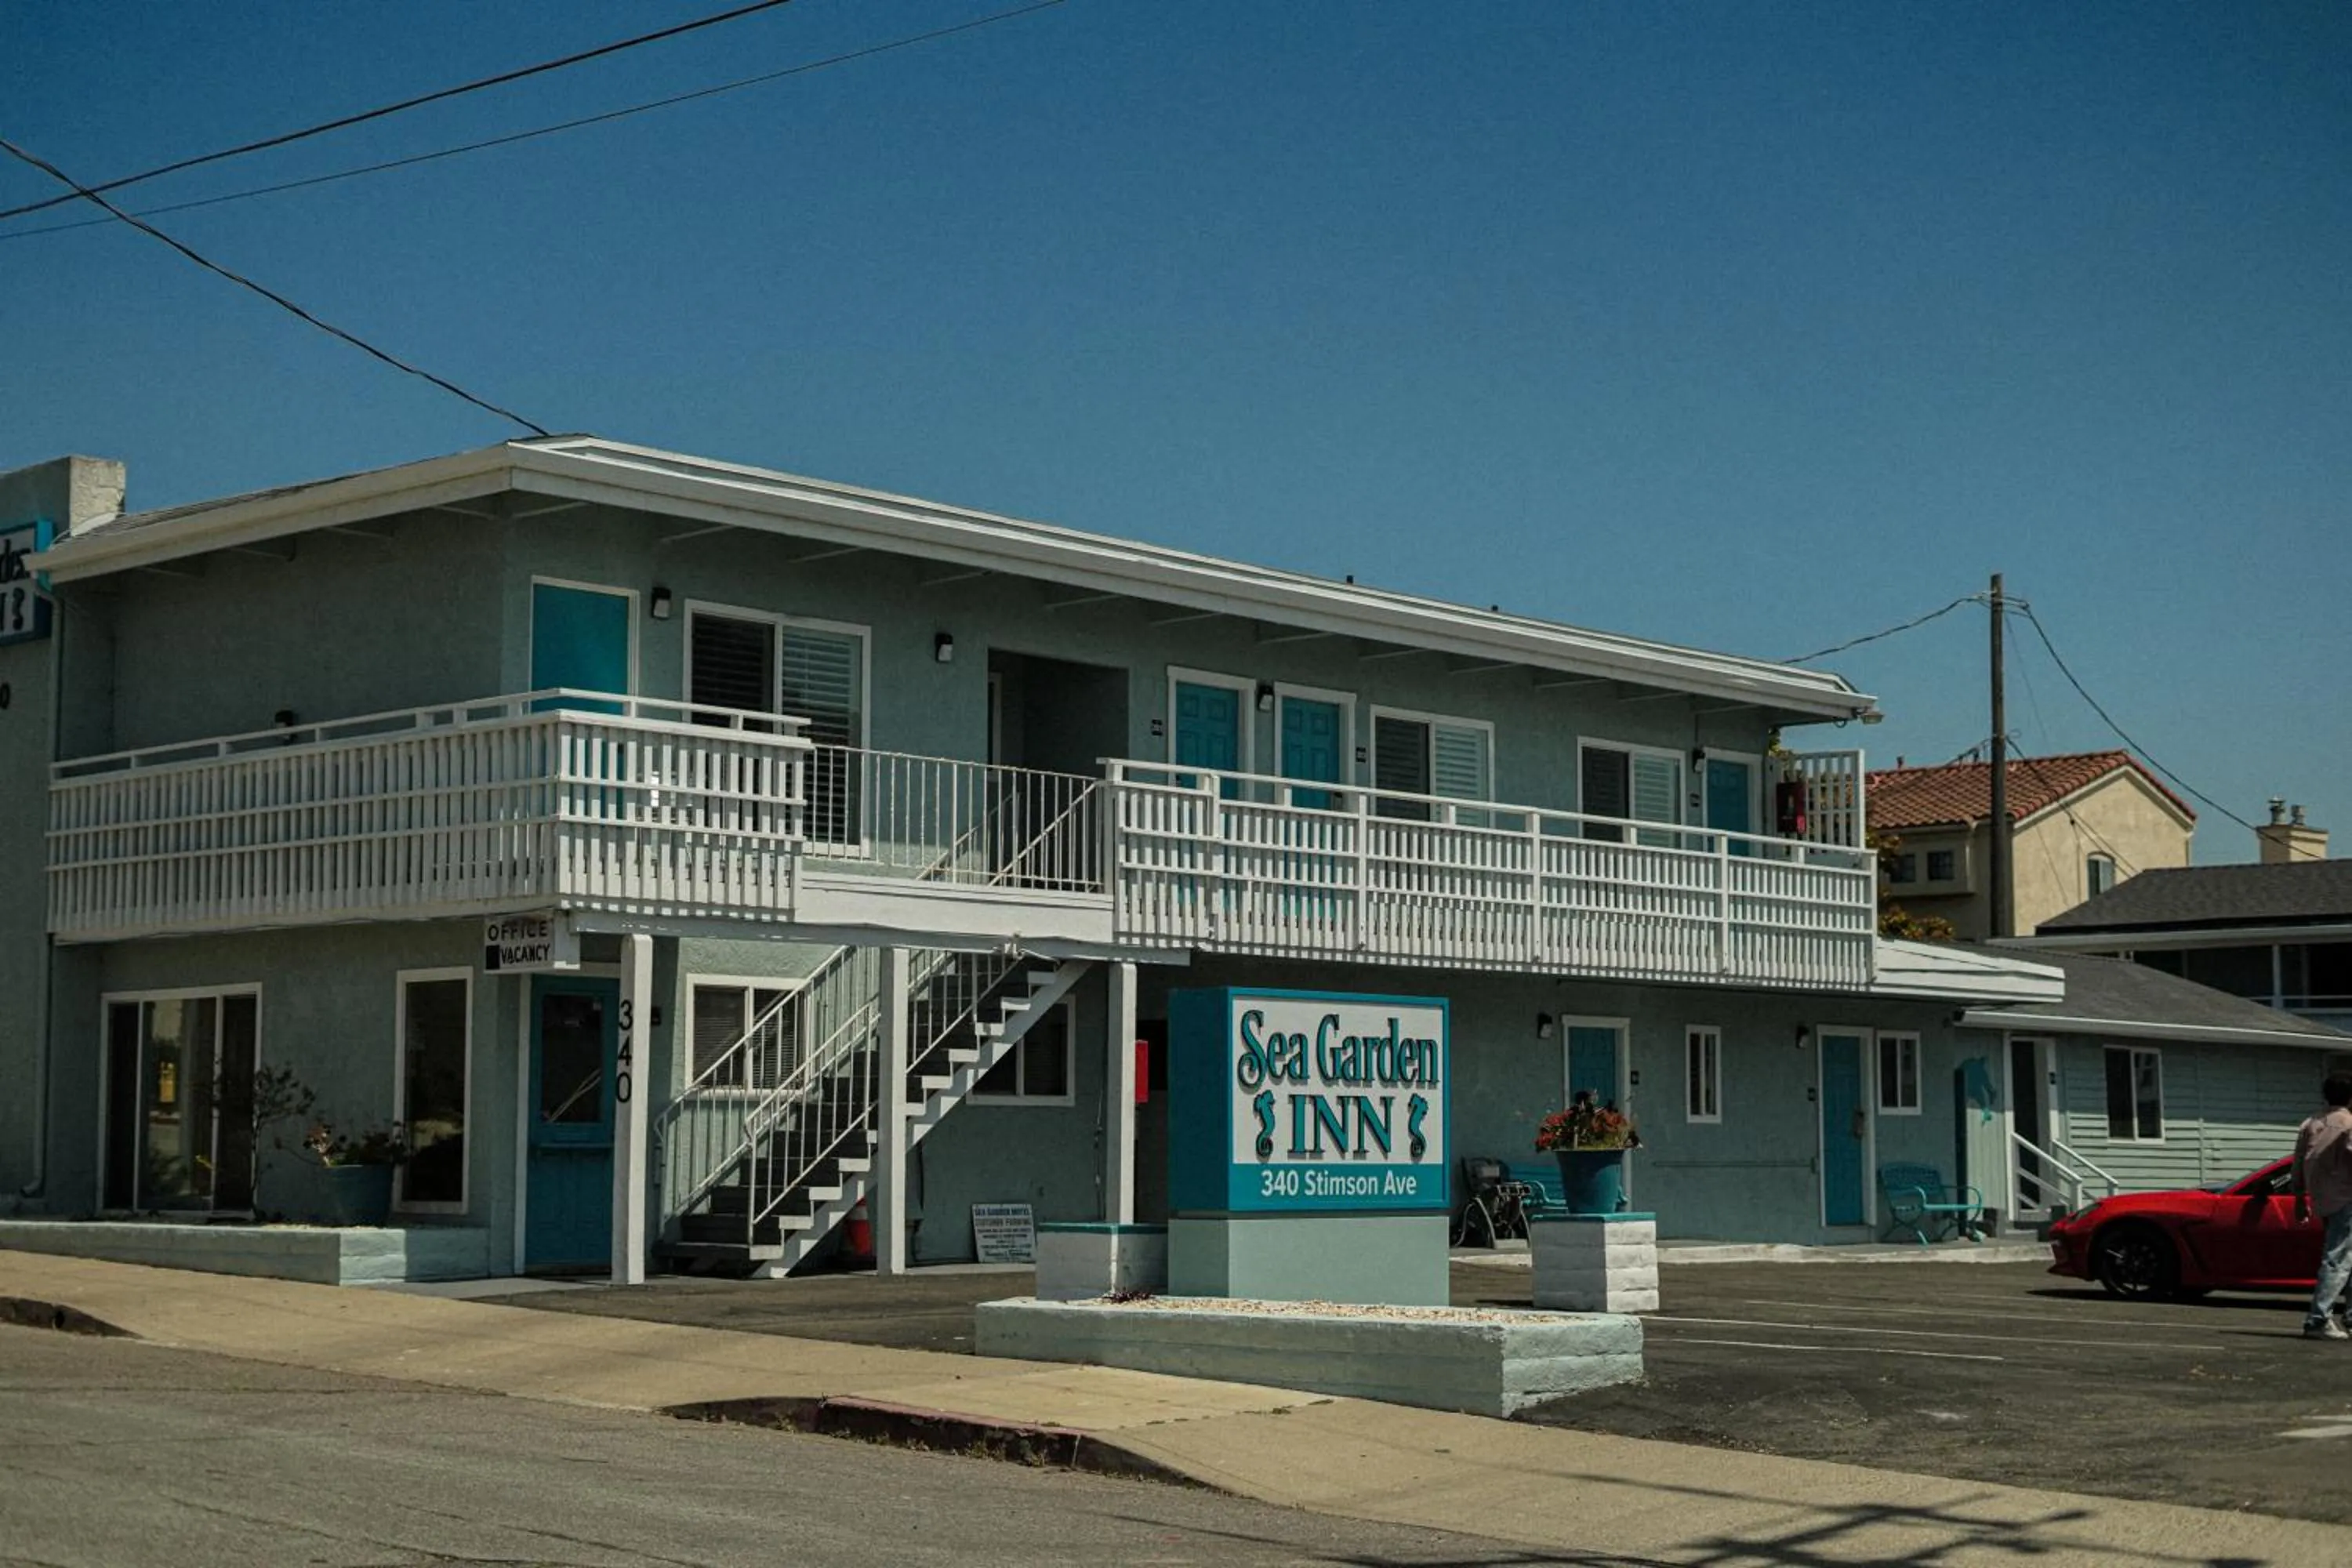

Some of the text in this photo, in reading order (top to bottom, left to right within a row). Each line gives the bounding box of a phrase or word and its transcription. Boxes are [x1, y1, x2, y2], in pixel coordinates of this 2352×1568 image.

[488, 920, 548, 941] OFFICE
[499, 944, 550, 964] VACANCY
[616, 1000, 633, 1103] 340
[1237, 1009, 1439, 1088] Sea Garden
[1287, 1094, 1395, 1156] INN
[1261, 1170, 1417, 1196] 340 Stimson Ave
